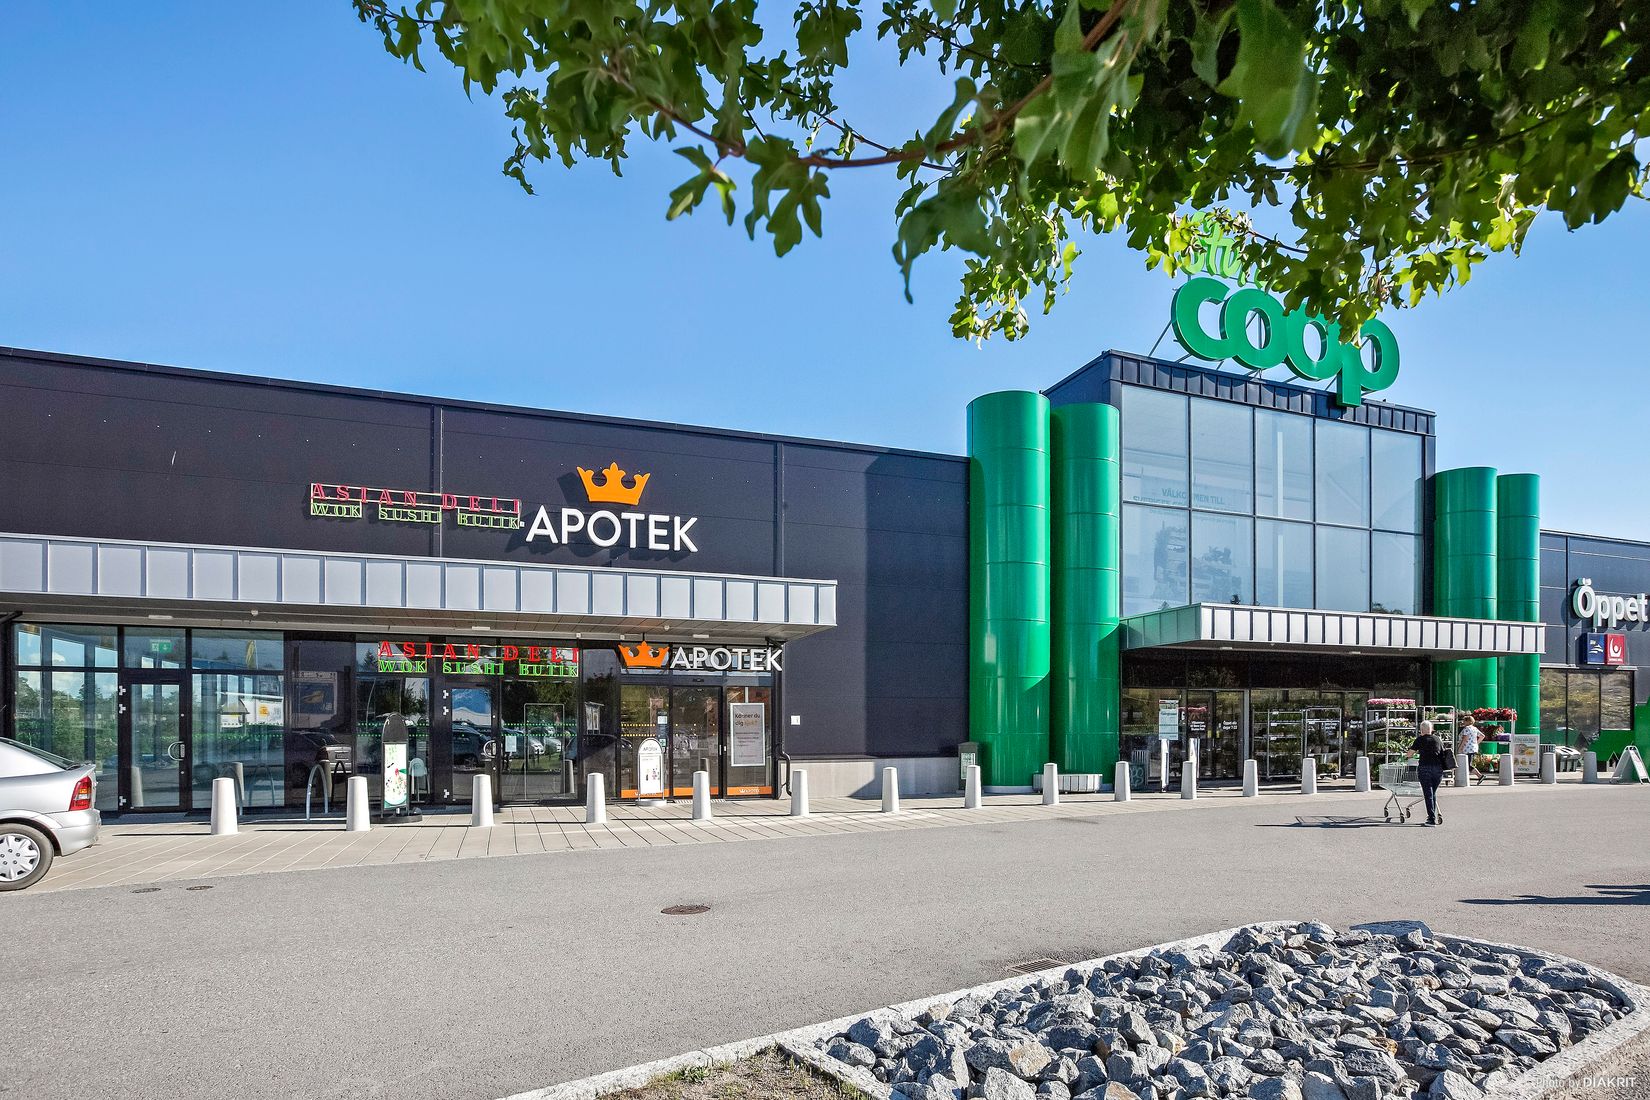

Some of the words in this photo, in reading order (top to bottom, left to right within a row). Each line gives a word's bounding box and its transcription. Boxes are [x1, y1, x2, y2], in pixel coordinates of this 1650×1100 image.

[1171, 277, 1400, 407] coop
[311, 482, 417, 508] ASIAN
[441, 493, 520, 514] DELI
[1161, 487, 1210, 504] VÄLKOMEN
[311, 502, 361, 517] WOK
[379, 507, 442, 523] SUSHI
[457, 512, 520, 530] BUTIK
[525, 504, 699, 553] APOTEK
[1573, 577, 1649, 628] Öppet
[378, 640, 480, 660] ASIAN
[503, 645, 580, 662] DELI
[669, 646, 783, 672] APOTEK
[378, 659, 428, 673] WOK
[443, 661, 504, 675] SUSHI
[519, 663, 579, 677] BUTIK
